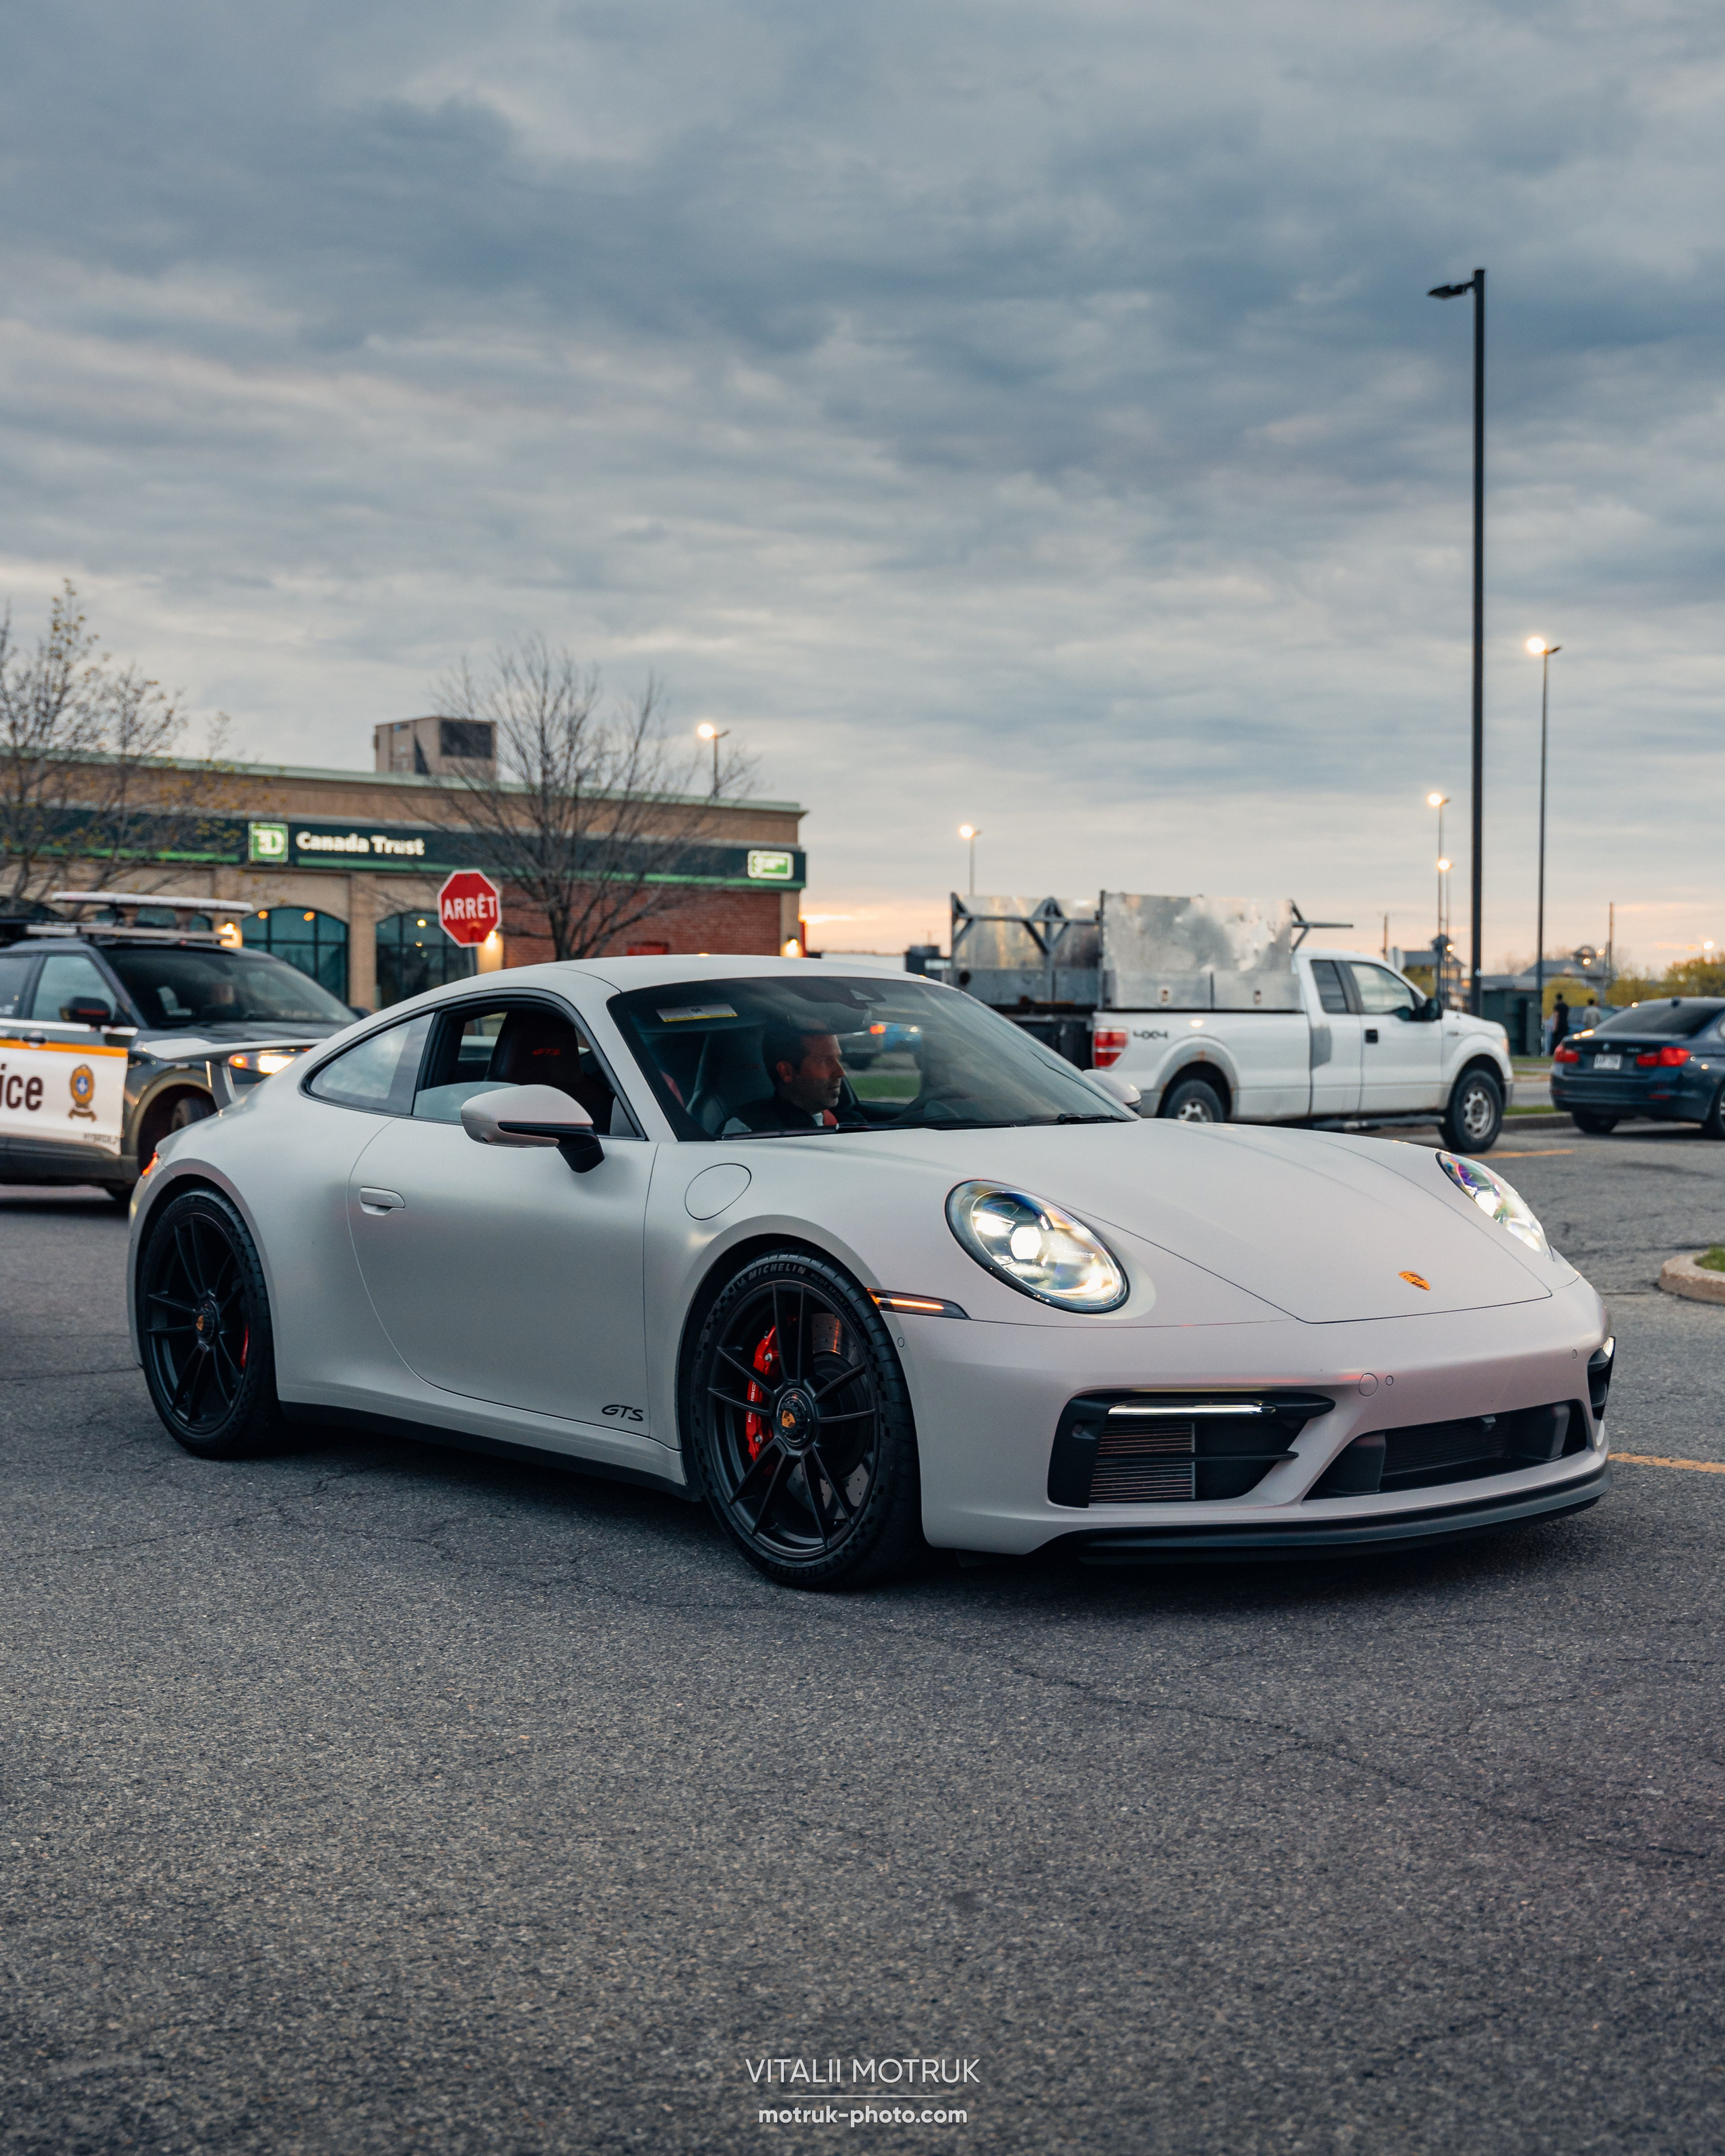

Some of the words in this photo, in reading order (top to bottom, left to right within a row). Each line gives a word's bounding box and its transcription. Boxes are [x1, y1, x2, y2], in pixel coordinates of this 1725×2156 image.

[253, 829, 284, 855] TD
[296, 831, 369, 853] Canada
[371, 835, 425, 856] Trust
[443, 893, 496, 921] ARRÊT
[749, 1263, 807, 1280] MICHELIN
[811, 1273, 827, 1287] PILOT
[829, 1286, 848, 1306] SPORT
[848, 1308, 859, 1324] CUP
[602, 1404, 644, 1422] GTS
